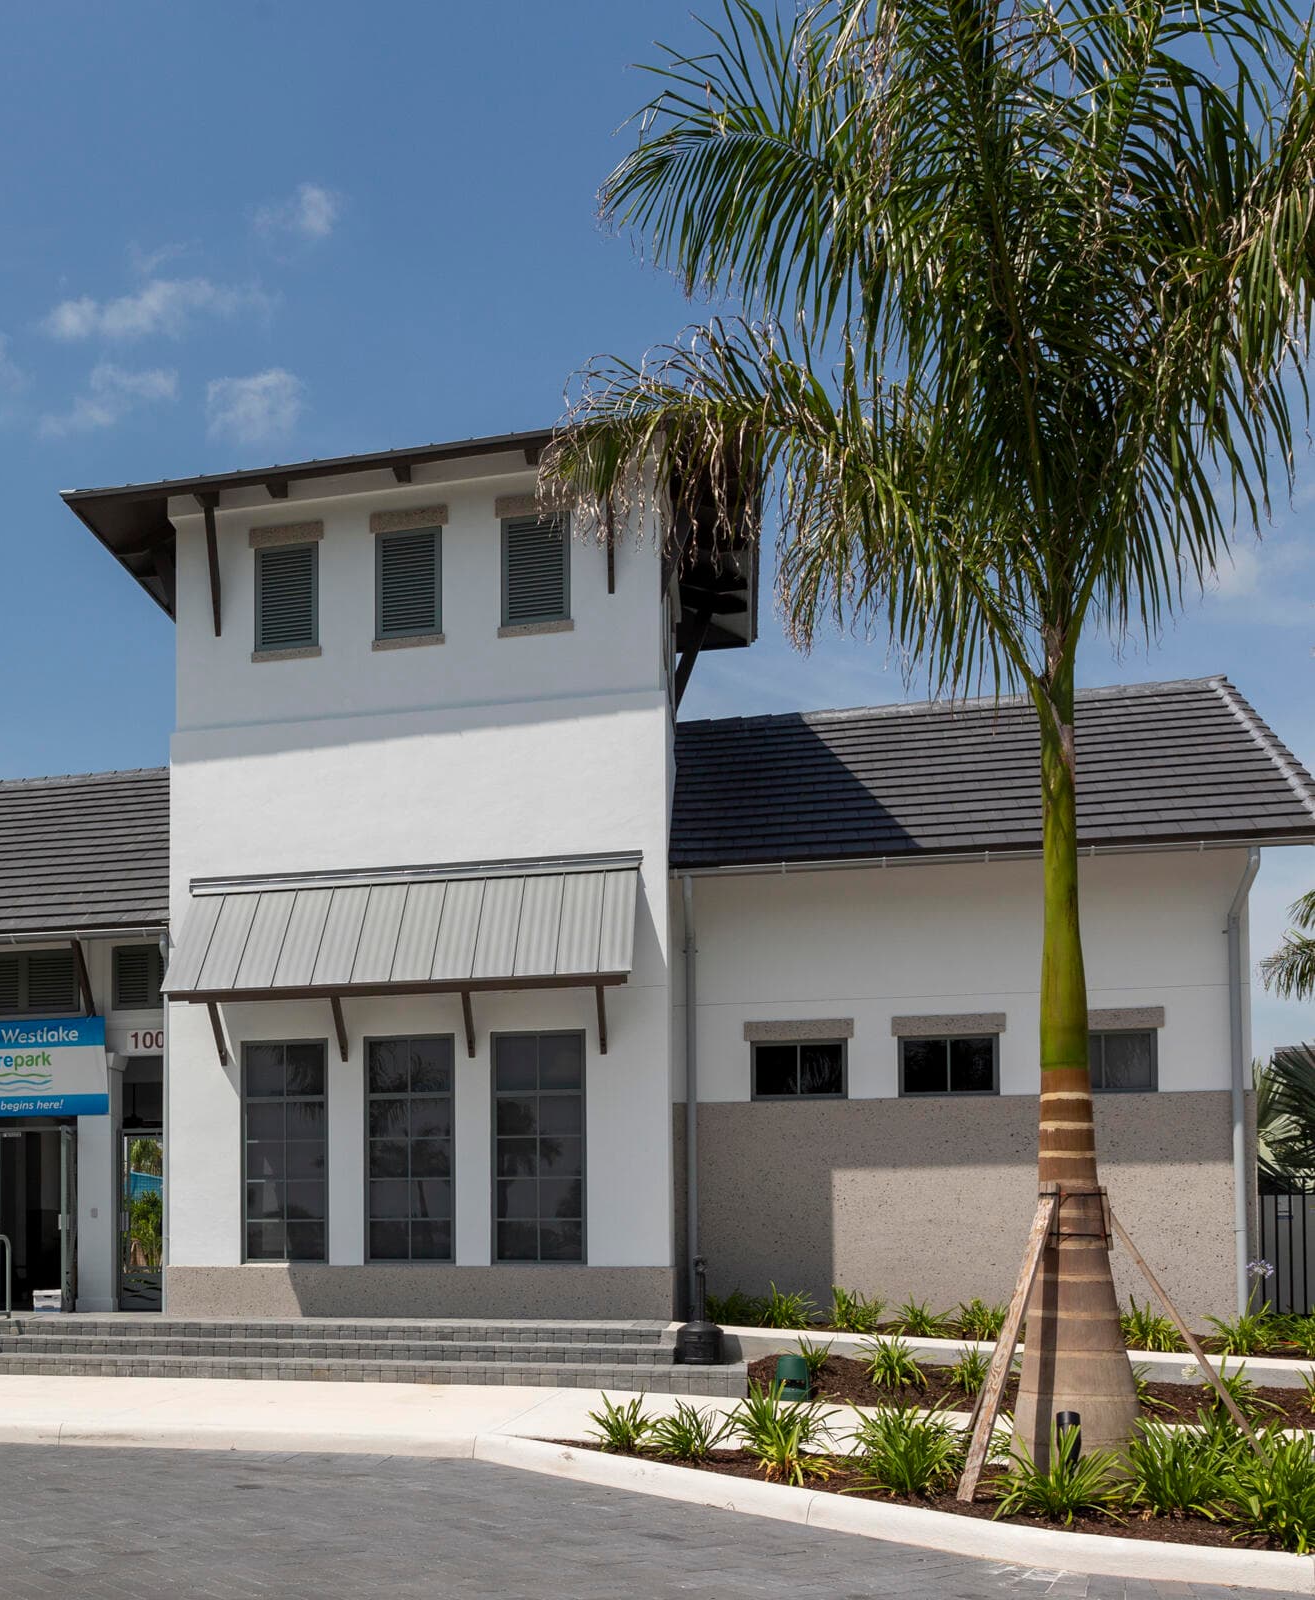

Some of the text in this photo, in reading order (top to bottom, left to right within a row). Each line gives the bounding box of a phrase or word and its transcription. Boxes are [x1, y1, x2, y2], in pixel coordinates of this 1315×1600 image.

[1, 1026, 79, 1044] Westlake
[0, 1100, 34, 1112] begins
[36, 1099, 64, 1109] here!
